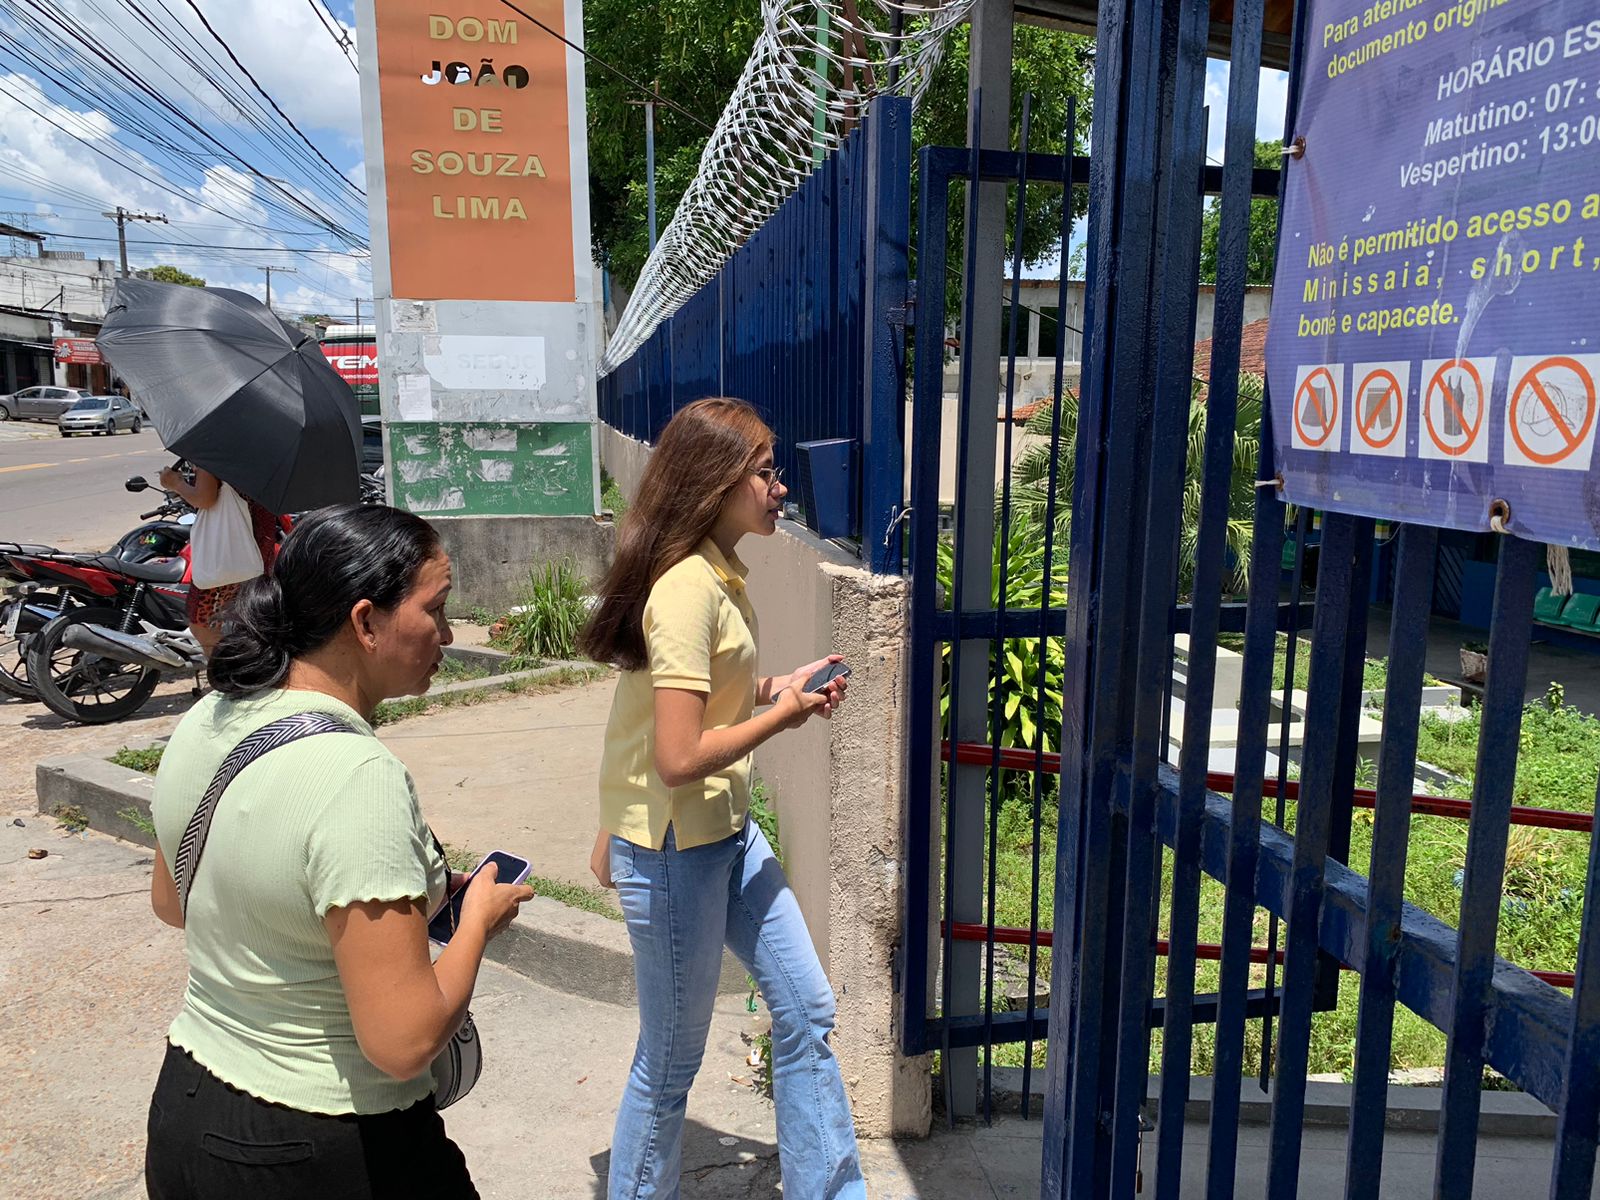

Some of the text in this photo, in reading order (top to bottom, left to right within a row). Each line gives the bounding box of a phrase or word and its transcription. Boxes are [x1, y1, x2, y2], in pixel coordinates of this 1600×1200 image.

[428, 14, 518, 45] DOM
[1323, 16, 1359, 49] Para
[1327, 20, 1428, 79] documento
[1437, 36, 1555, 101] HORÁRIO
[452, 107, 504, 133] DE
[1424, 97, 1536, 147] Matutino:
[1545, 77, 1587, 113] 07:
[410, 150, 547, 178] SOUZA
[1400, 115, 1600, 188] Vespertino: 13:0
[432, 195, 528, 221] LIMA
[1307, 242, 1335, 269] Não
[1338, 234, 1349, 261] é
[1353, 215, 1459, 265] permitido
[1466, 199, 1572, 239] acesso
[1297, 299, 1459, 337] boné e capacete.
